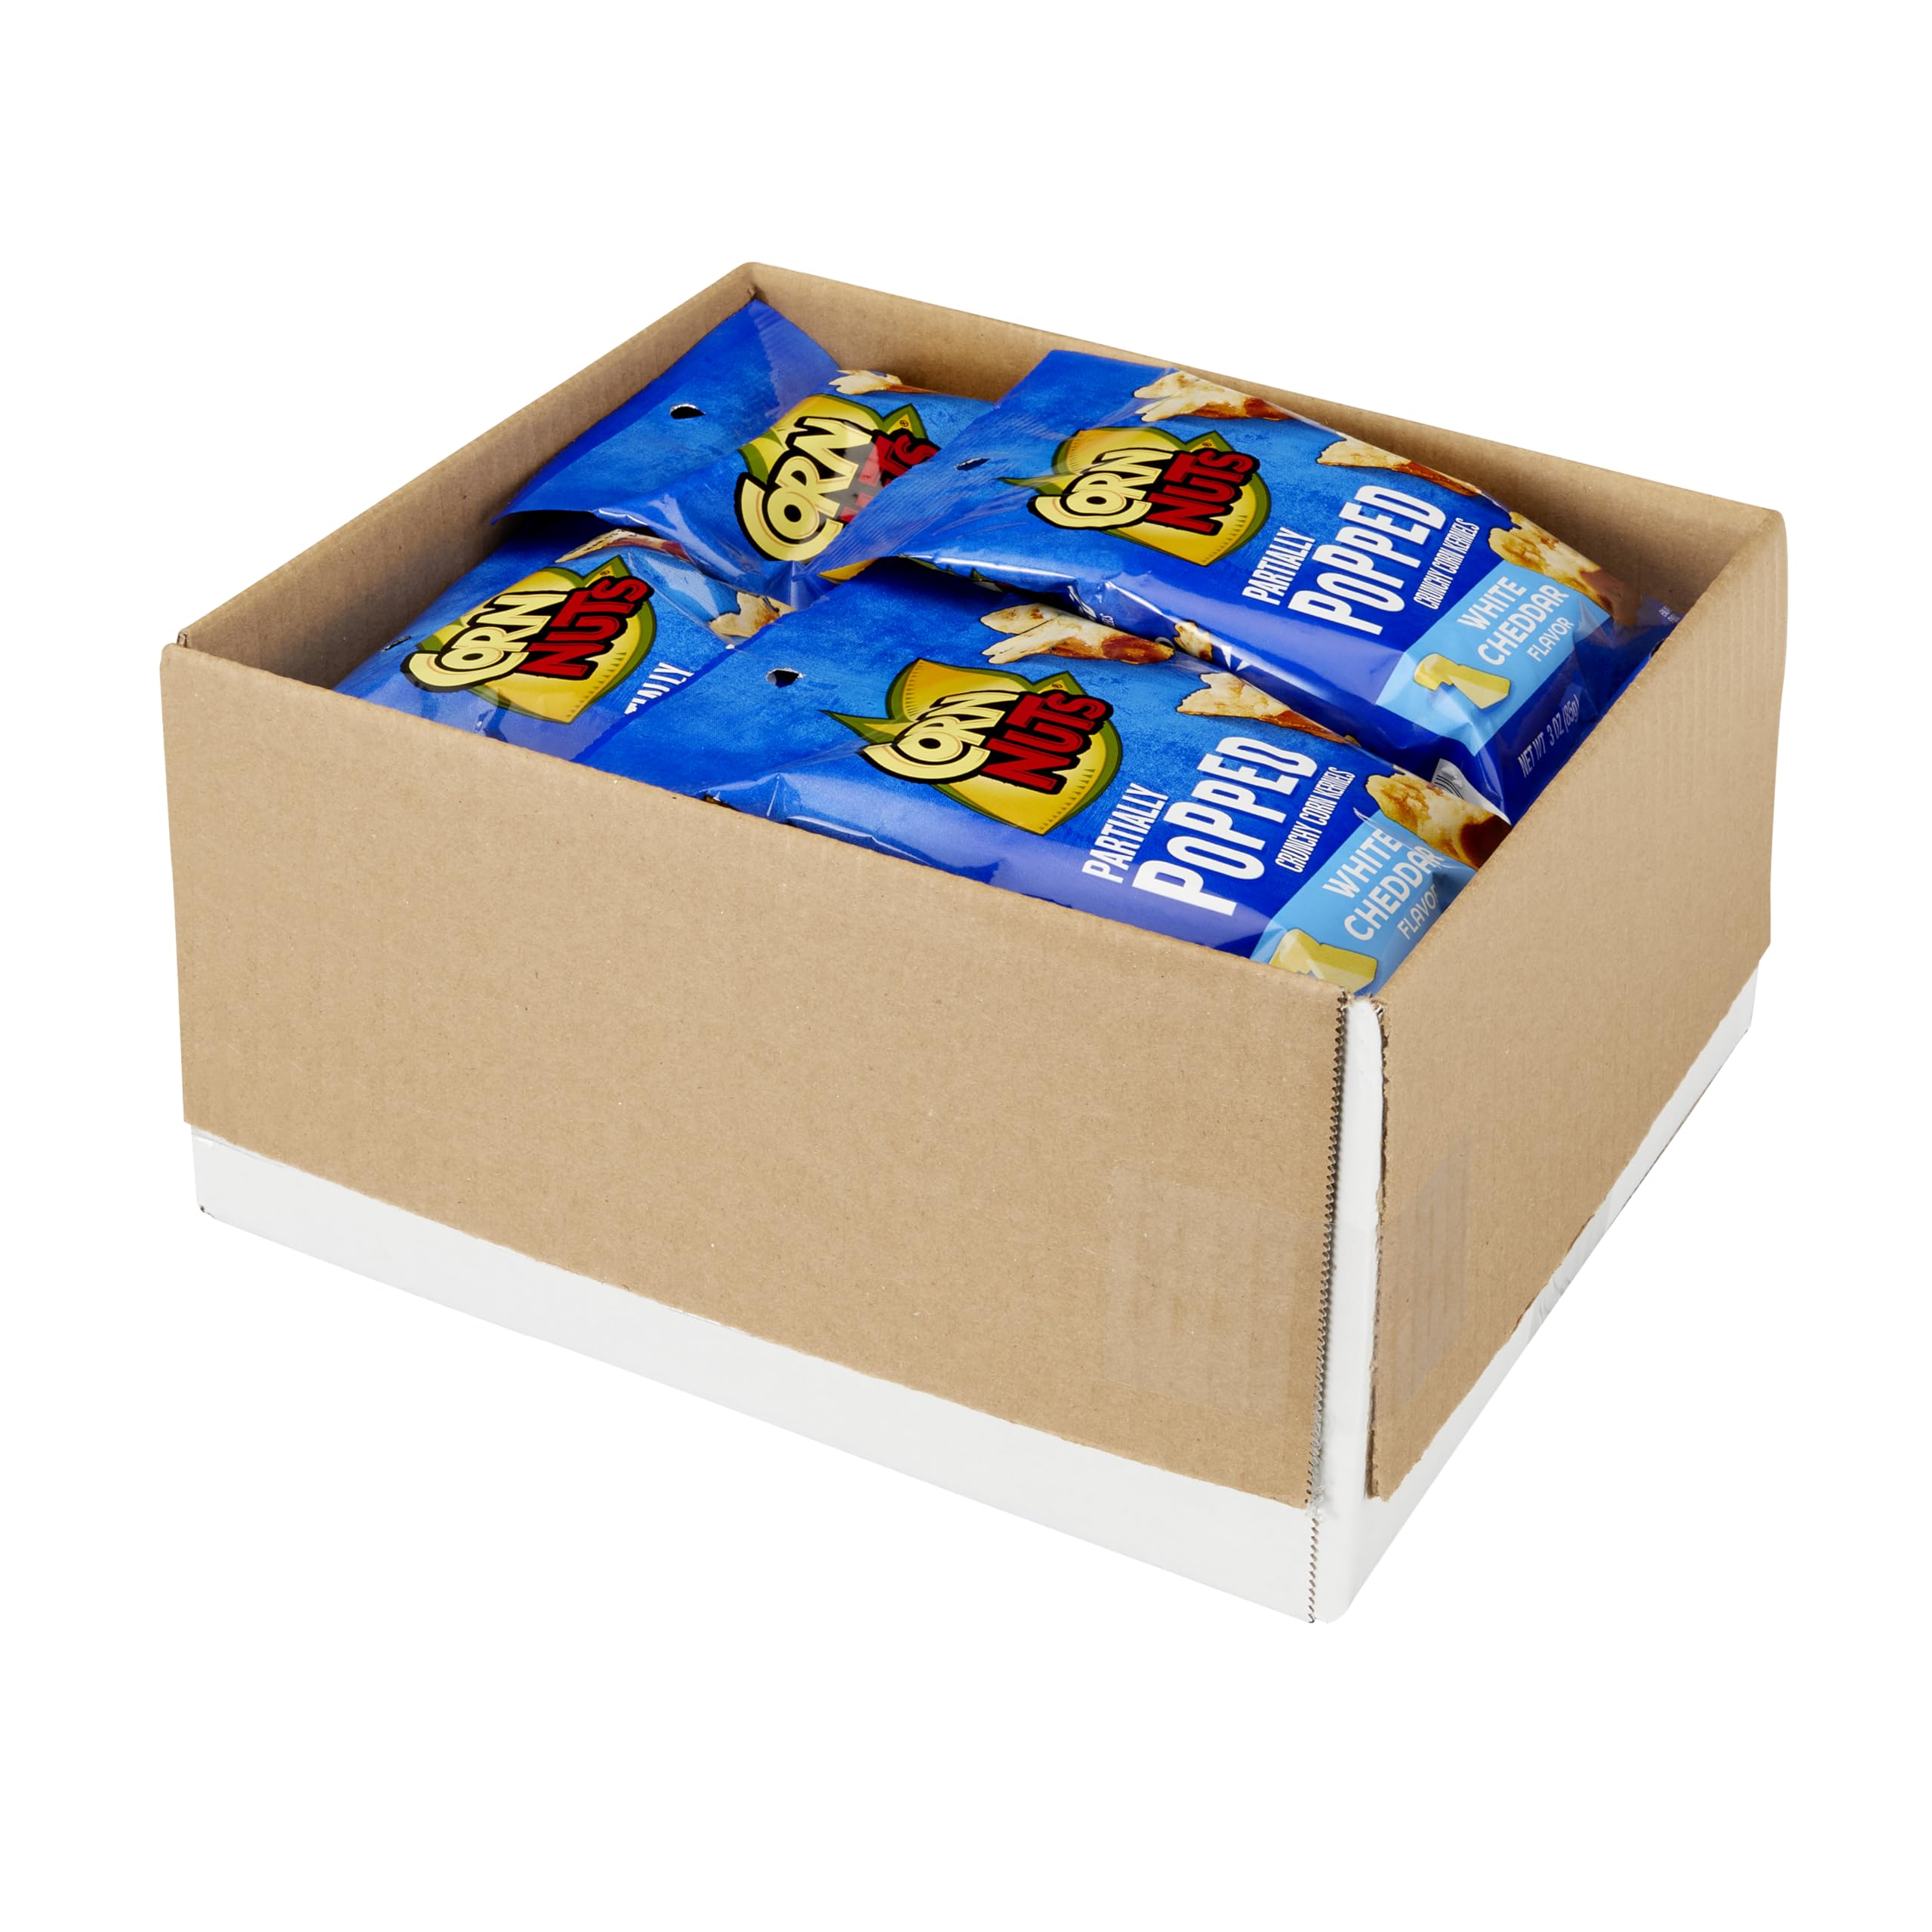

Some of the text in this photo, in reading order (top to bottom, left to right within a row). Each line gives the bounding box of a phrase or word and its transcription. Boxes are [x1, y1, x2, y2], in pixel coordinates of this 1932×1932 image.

[740, 417, 872, 561] CORN
[1035, 448, 1174, 528] CORN
[1146, 450, 1254, 534] NUTS
[1242, 527, 1318, 606] PARTIALLY
[1287, 485, 1447, 635] POPPED
[1414, 517, 1480, 610] CRUNCHY CORN KERNELS
[1457, 577, 1527, 631] WHITE
[408, 593, 568, 688] CORN
[518, 579, 648, 678] NUTS
[1478, 584, 1570, 666] CHEDDAR
[1526, 617, 1574, 663] FLAVOR
[865, 691, 1021, 780] CORN
[983, 692, 1108, 792] NUTS
[1517, 694, 1580, 778] NET WT 3 OZ (85g)
[1082, 783, 1170, 884] PARTIALLY
[1132, 737, 1318, 916] POPPED
[1275, 766, 1355, 873] CRUNCHY CORN KERNELS
[1322, 829, 1404, 899] WHITE
[1344, 845, 1444, 941] CHEDDAR
